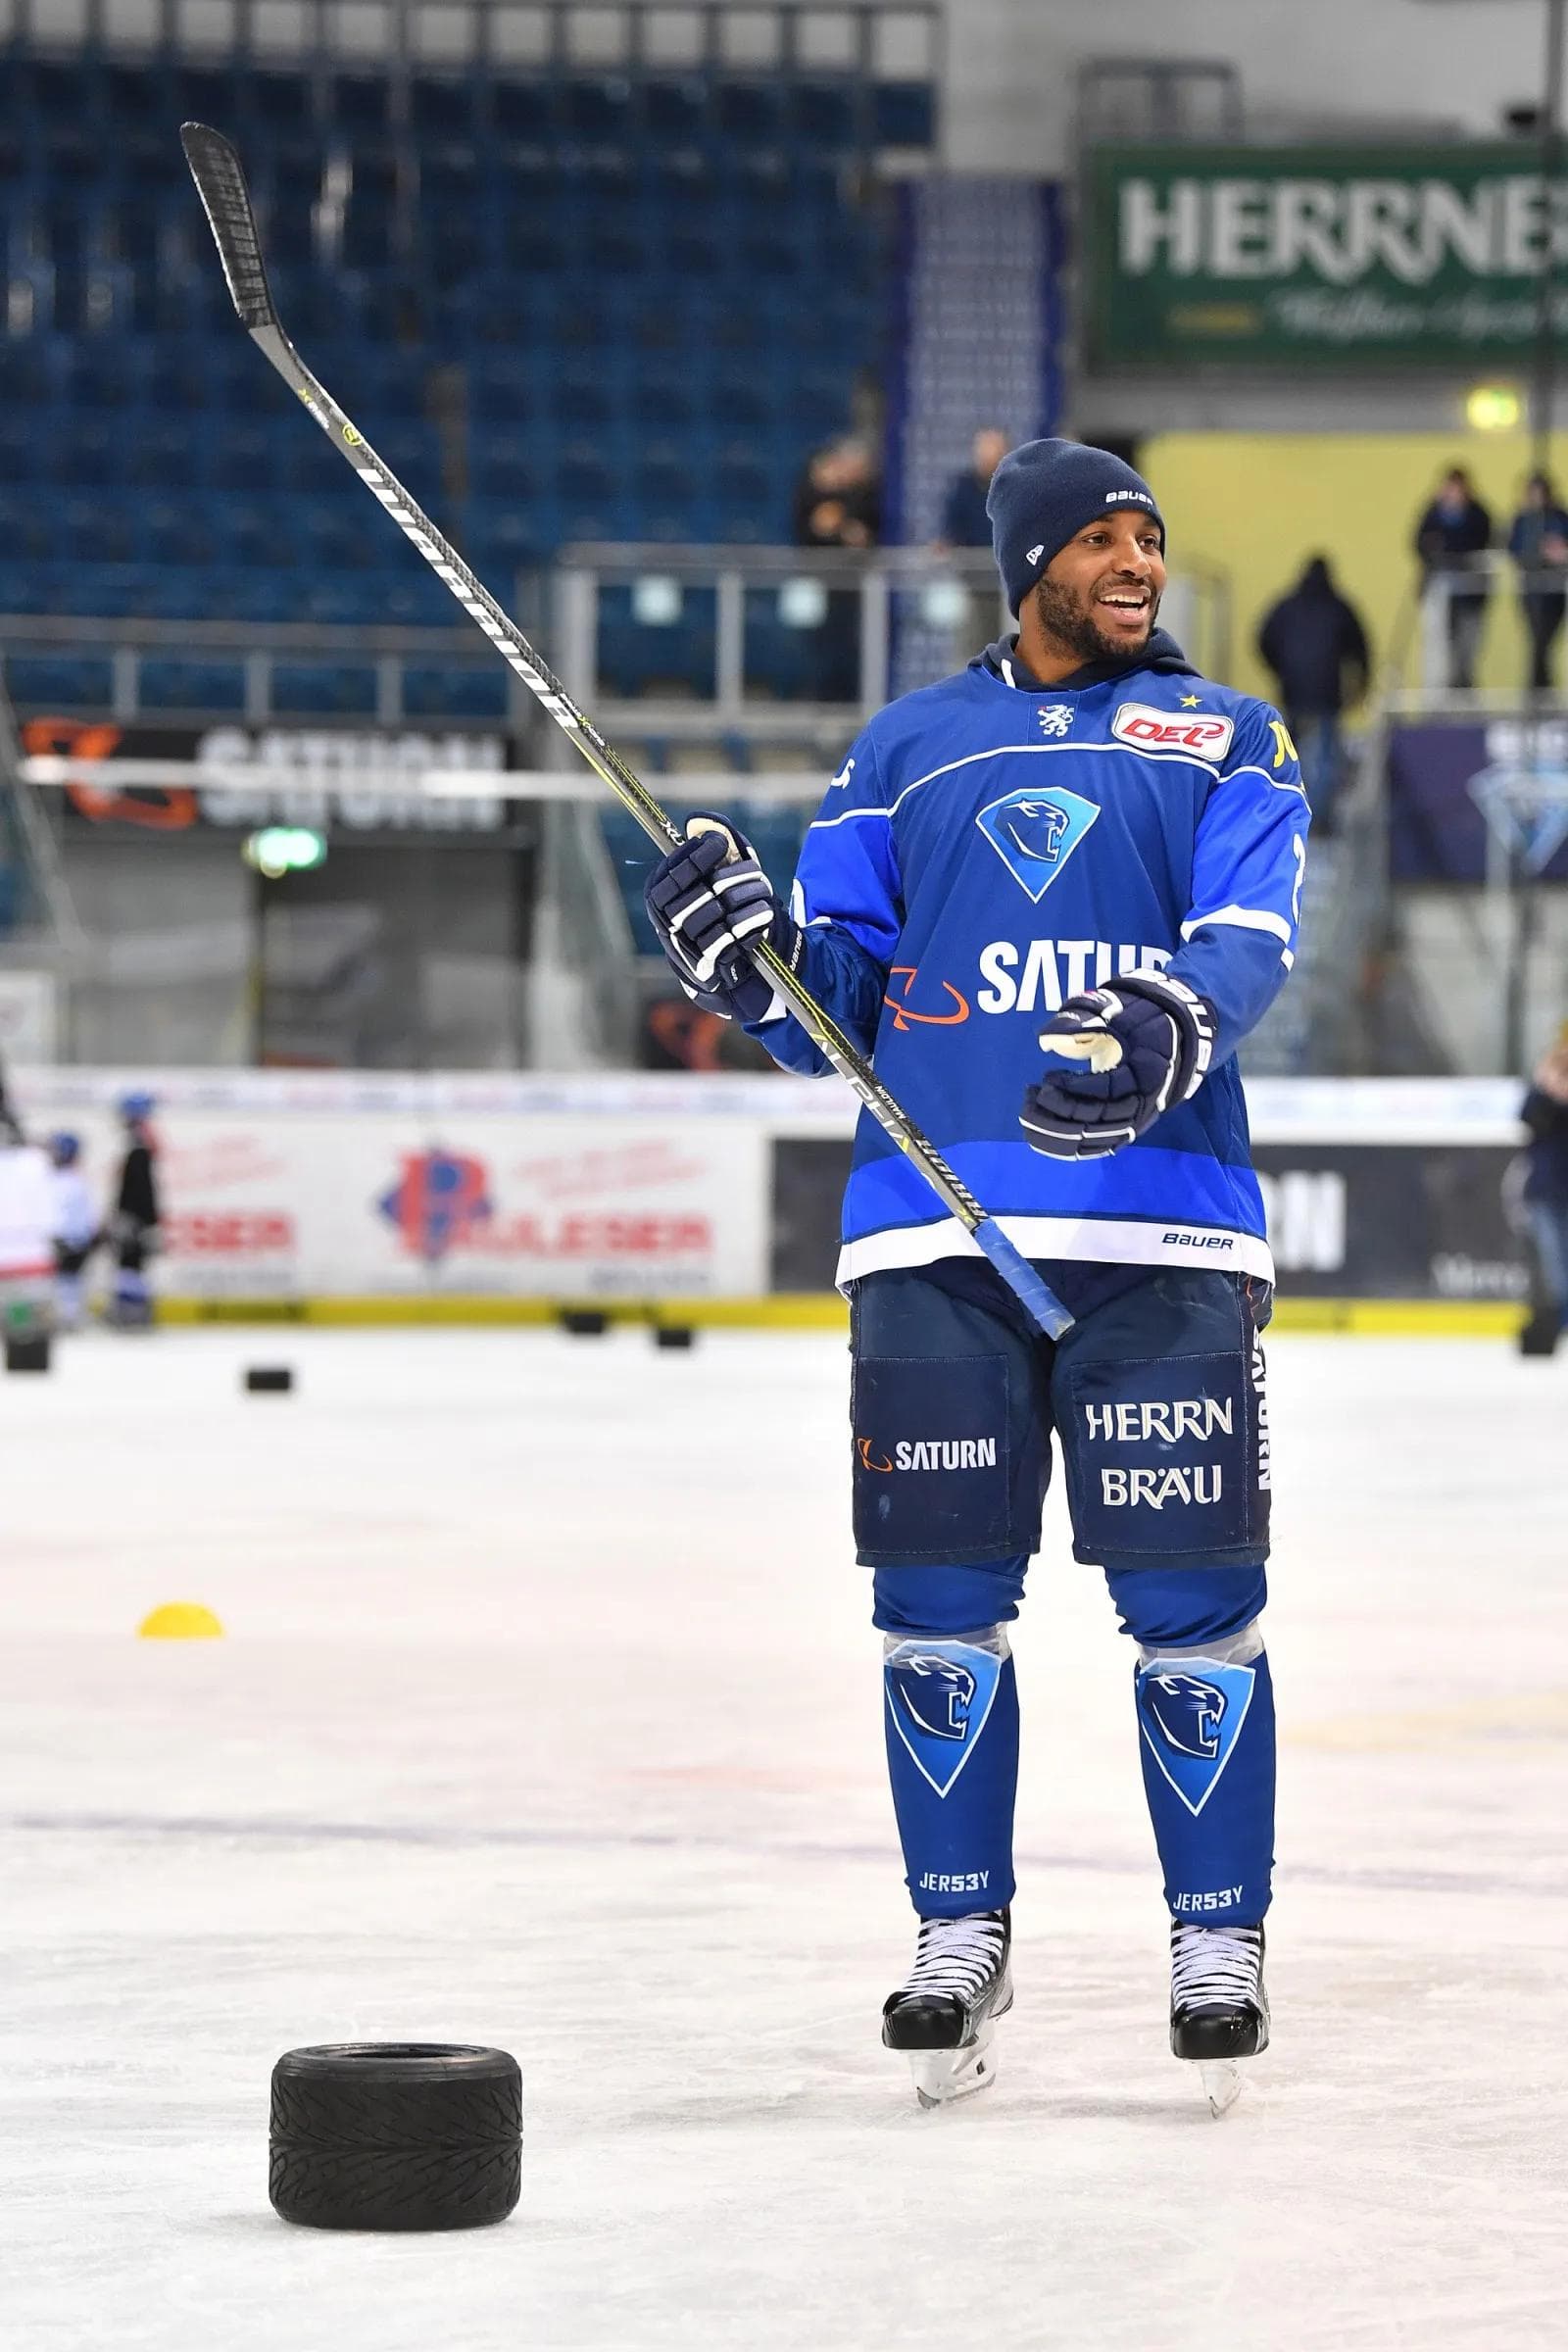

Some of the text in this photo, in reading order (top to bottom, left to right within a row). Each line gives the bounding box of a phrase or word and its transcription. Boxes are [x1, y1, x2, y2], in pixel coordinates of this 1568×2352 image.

[356, 468, 578, 728] WARRIOR
[874, 1085, 907, 1120] MAULDIN
[1085, 1396, 1233, 1443] HERRN
[896, 1438, 996, 1470] SATURN
[1102, 1464, 1222, 1509] BRÄU
[919, 1870, 989, 1892] JER53Y
[1173, 1885, 1243, 1912] JER53Y
